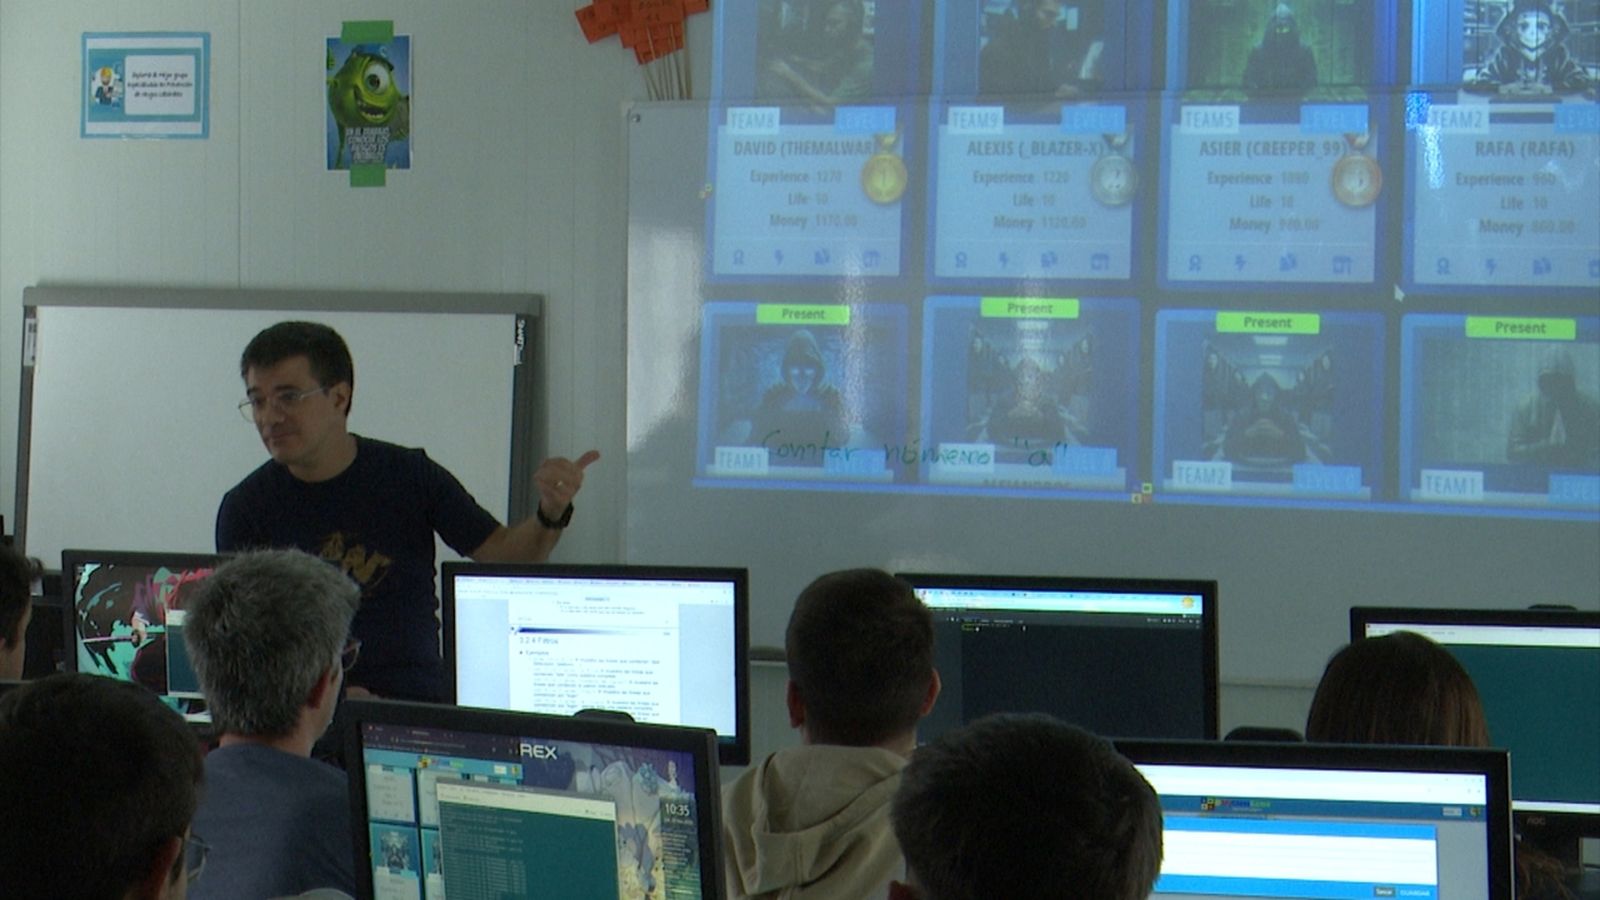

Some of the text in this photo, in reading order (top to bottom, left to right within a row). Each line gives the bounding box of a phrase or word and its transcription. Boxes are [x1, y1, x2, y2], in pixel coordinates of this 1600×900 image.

[952, 111, 999, 129] TEAM9
[1431, 110, 1483, 129] TEAM2
[733, 140, 777, 156] DAVID
[967, 140, 1014, 156] ALEXIS
[1200, 140, 1242, 157] ASIER
[1475, 140, 1574, 160] RAFA (RAFA)
[750, 169, 809, 187] Experience
[973, 170, 1035, 188] Experience
[1207, 170, 1272, 189] Experience
[1456, 172, 1524, 190] Experience
[788, 192, 808, 206] Life
[1013, 193, 1034, 207] Life
[1249, 195, 1272, 209] Life
[1500, 195, 1523, 210] Life
[769, 214, 808, 231] Money
[993, 216, 1034, 232] Money
[1229, 218, 1271, 234] Money
[1479, 219, 1523, 237] Money
[781, 308, 825, 320] Present
[1007, 302, 1054, 315] Present
[1244, 316, 1293, 329] Present
[1495, 321, 1546, 334] Present
[1177, 466, 1226, 487] TEAM2
[520, 742, 558, 761] REX
[664, 802, 690, 817] 10:35
